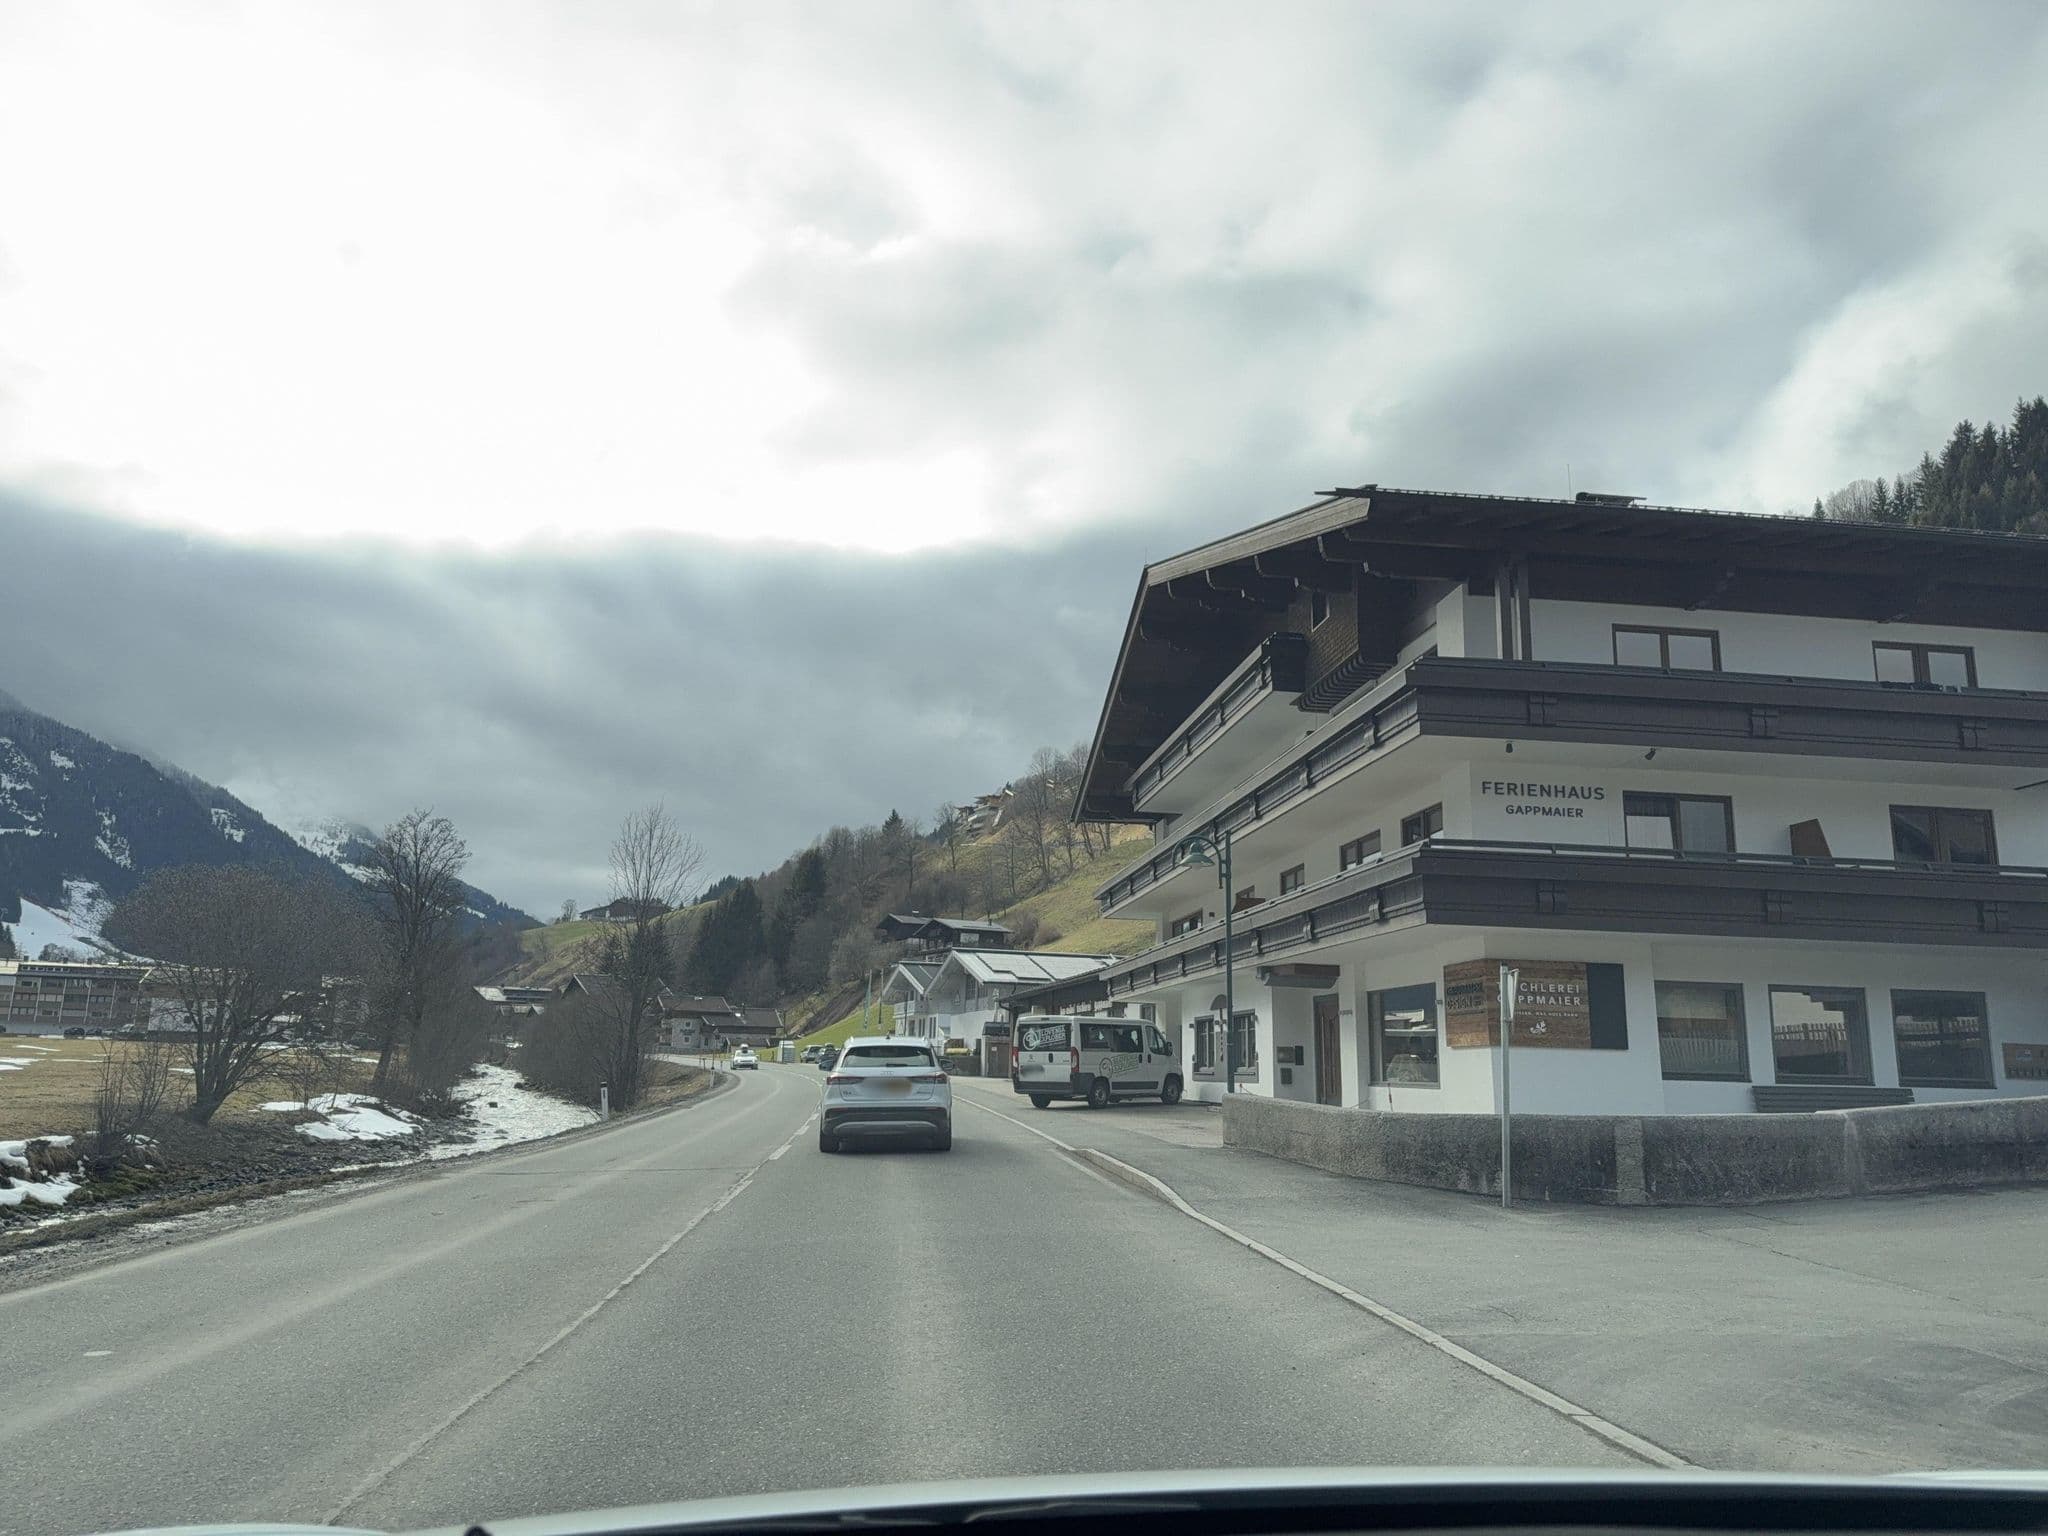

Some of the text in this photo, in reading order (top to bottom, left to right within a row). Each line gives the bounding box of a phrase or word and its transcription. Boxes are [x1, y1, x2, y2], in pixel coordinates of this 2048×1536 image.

[1481, 781, 1605, 800] FERIENHAUS
[1505, 805, 1584, 818] GAPPMAIER
[1496, 981, 1580, 993] CHLEREI
[1497, 994, 1580, 1006] GPPMAIER
